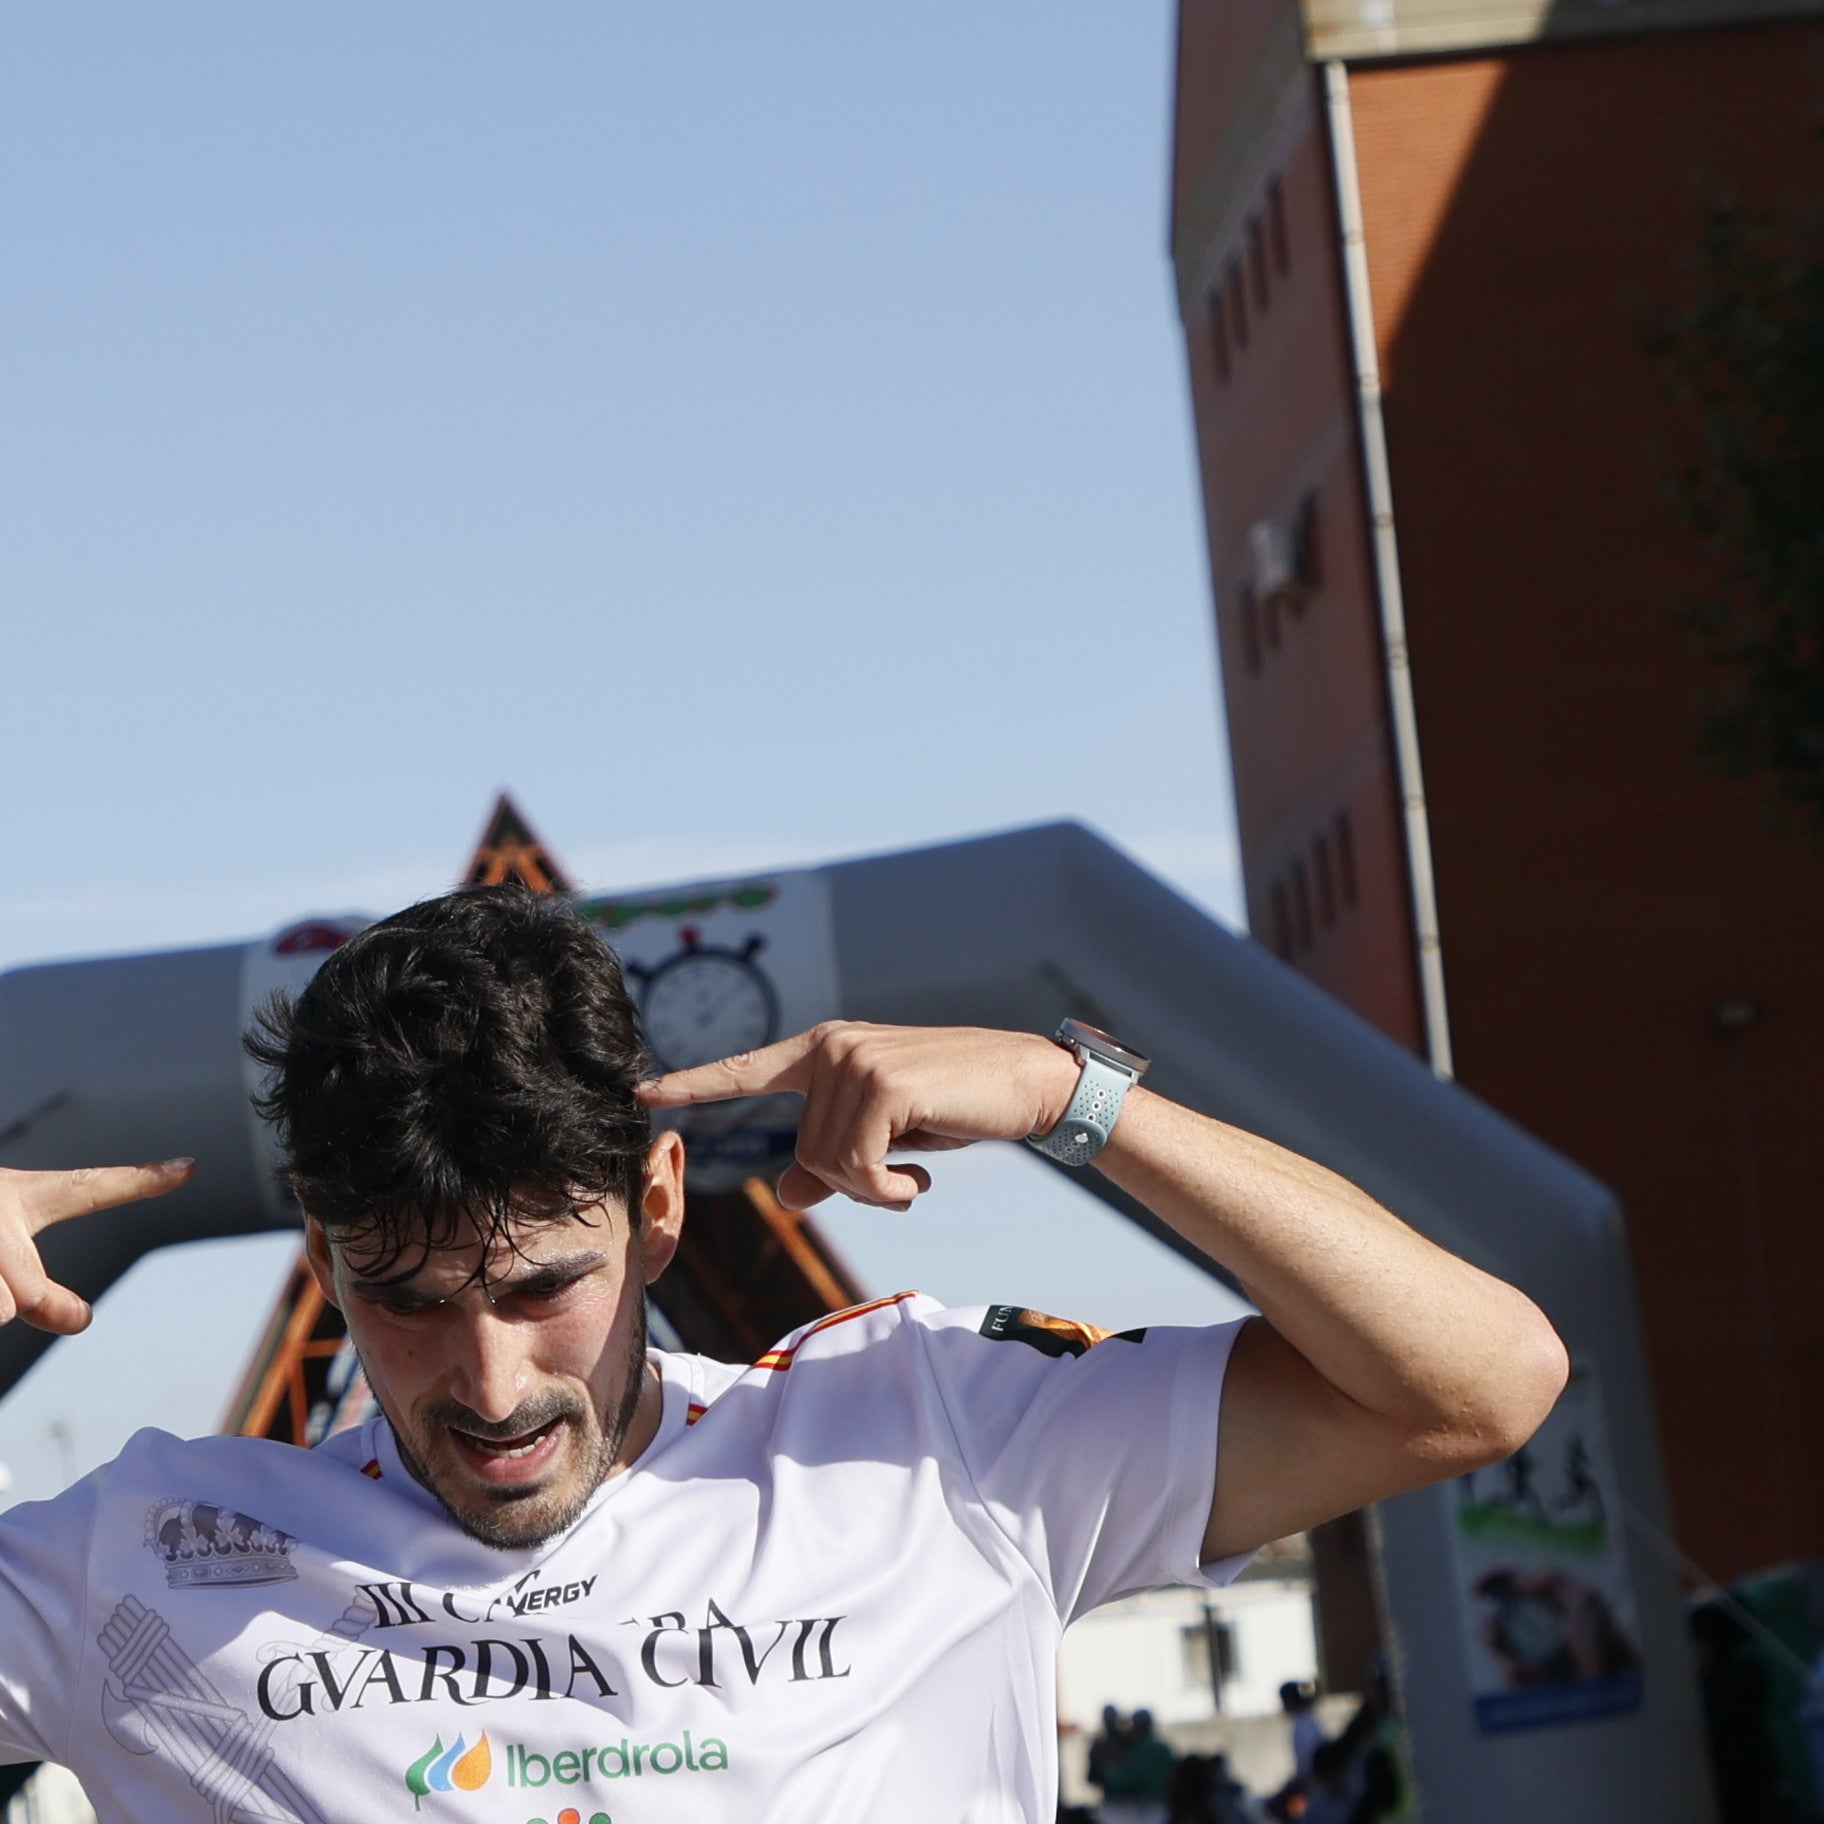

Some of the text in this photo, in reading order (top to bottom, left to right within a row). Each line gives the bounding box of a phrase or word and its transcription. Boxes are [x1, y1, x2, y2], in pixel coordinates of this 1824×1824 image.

[257, 1615, 852, 1721] GVARDIA CIVIL
[506, 1729, 730, 1788] Iberdrola
